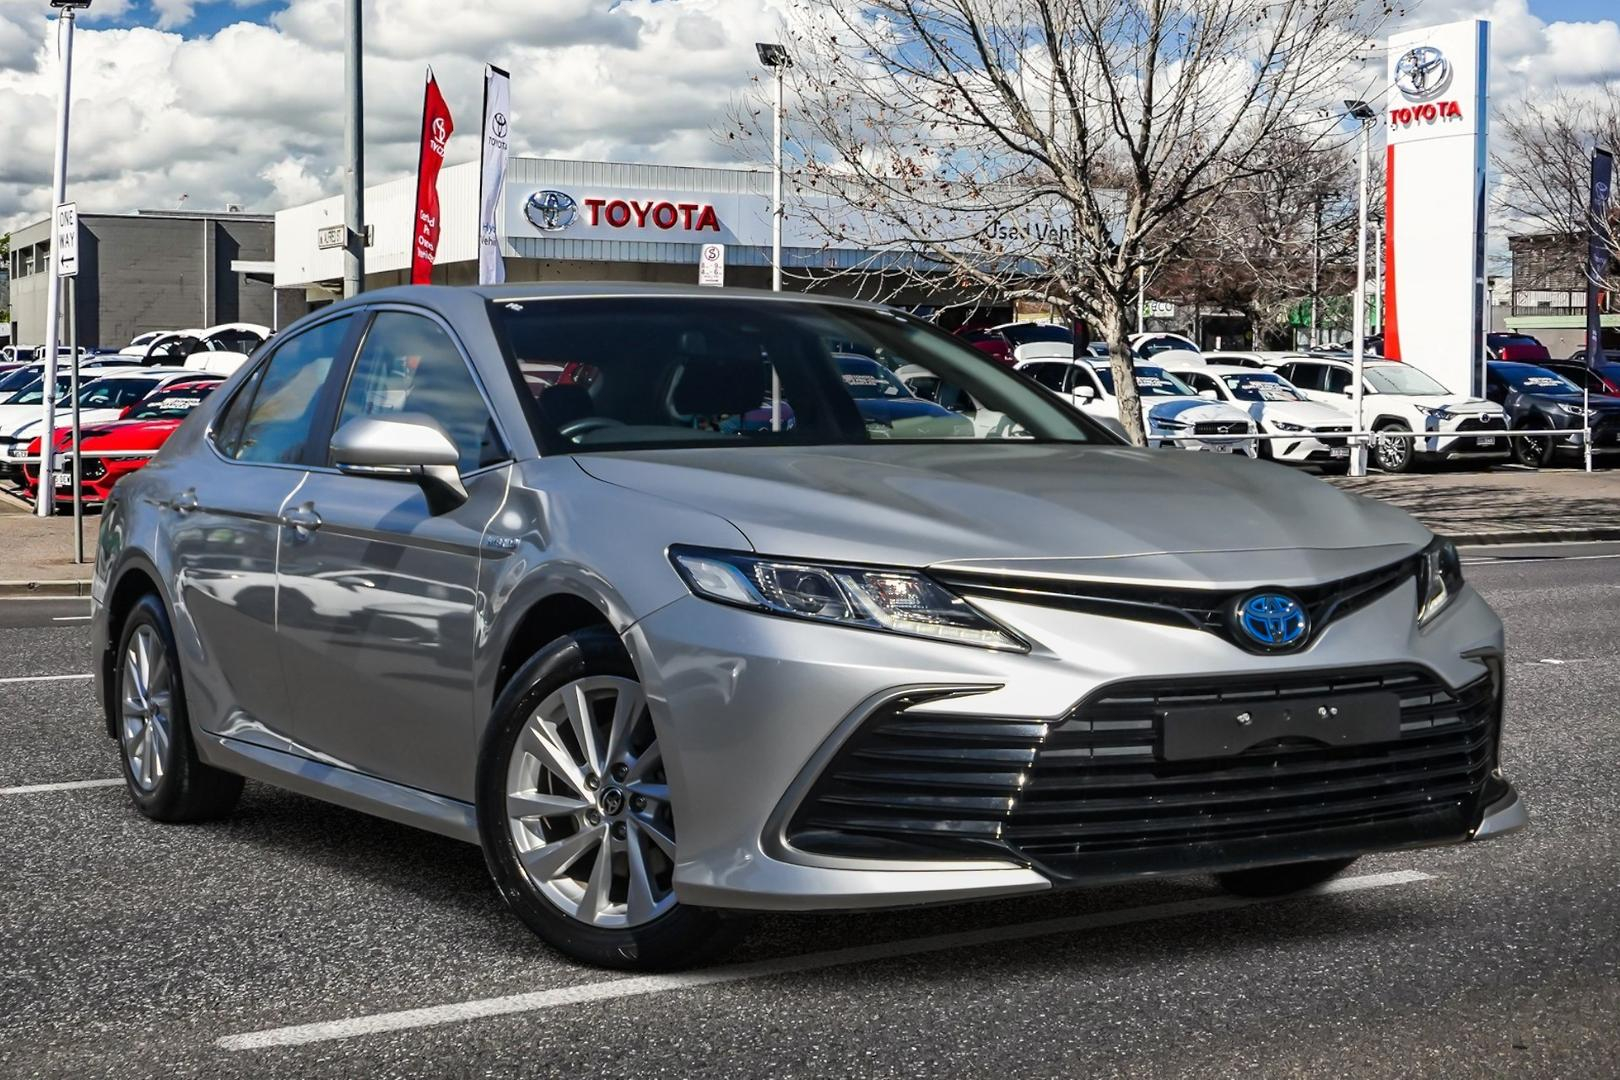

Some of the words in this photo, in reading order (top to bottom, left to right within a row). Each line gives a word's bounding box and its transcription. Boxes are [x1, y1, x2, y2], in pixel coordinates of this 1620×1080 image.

[1389, 101, 1463, 125] TOYOTA
[488, 136, 508, 151] TOYOTA
[59, 209, 74, 228] ONE
[584, 199, 721, 232] TOYOTA
[59, 231, 75, 249] WAY
